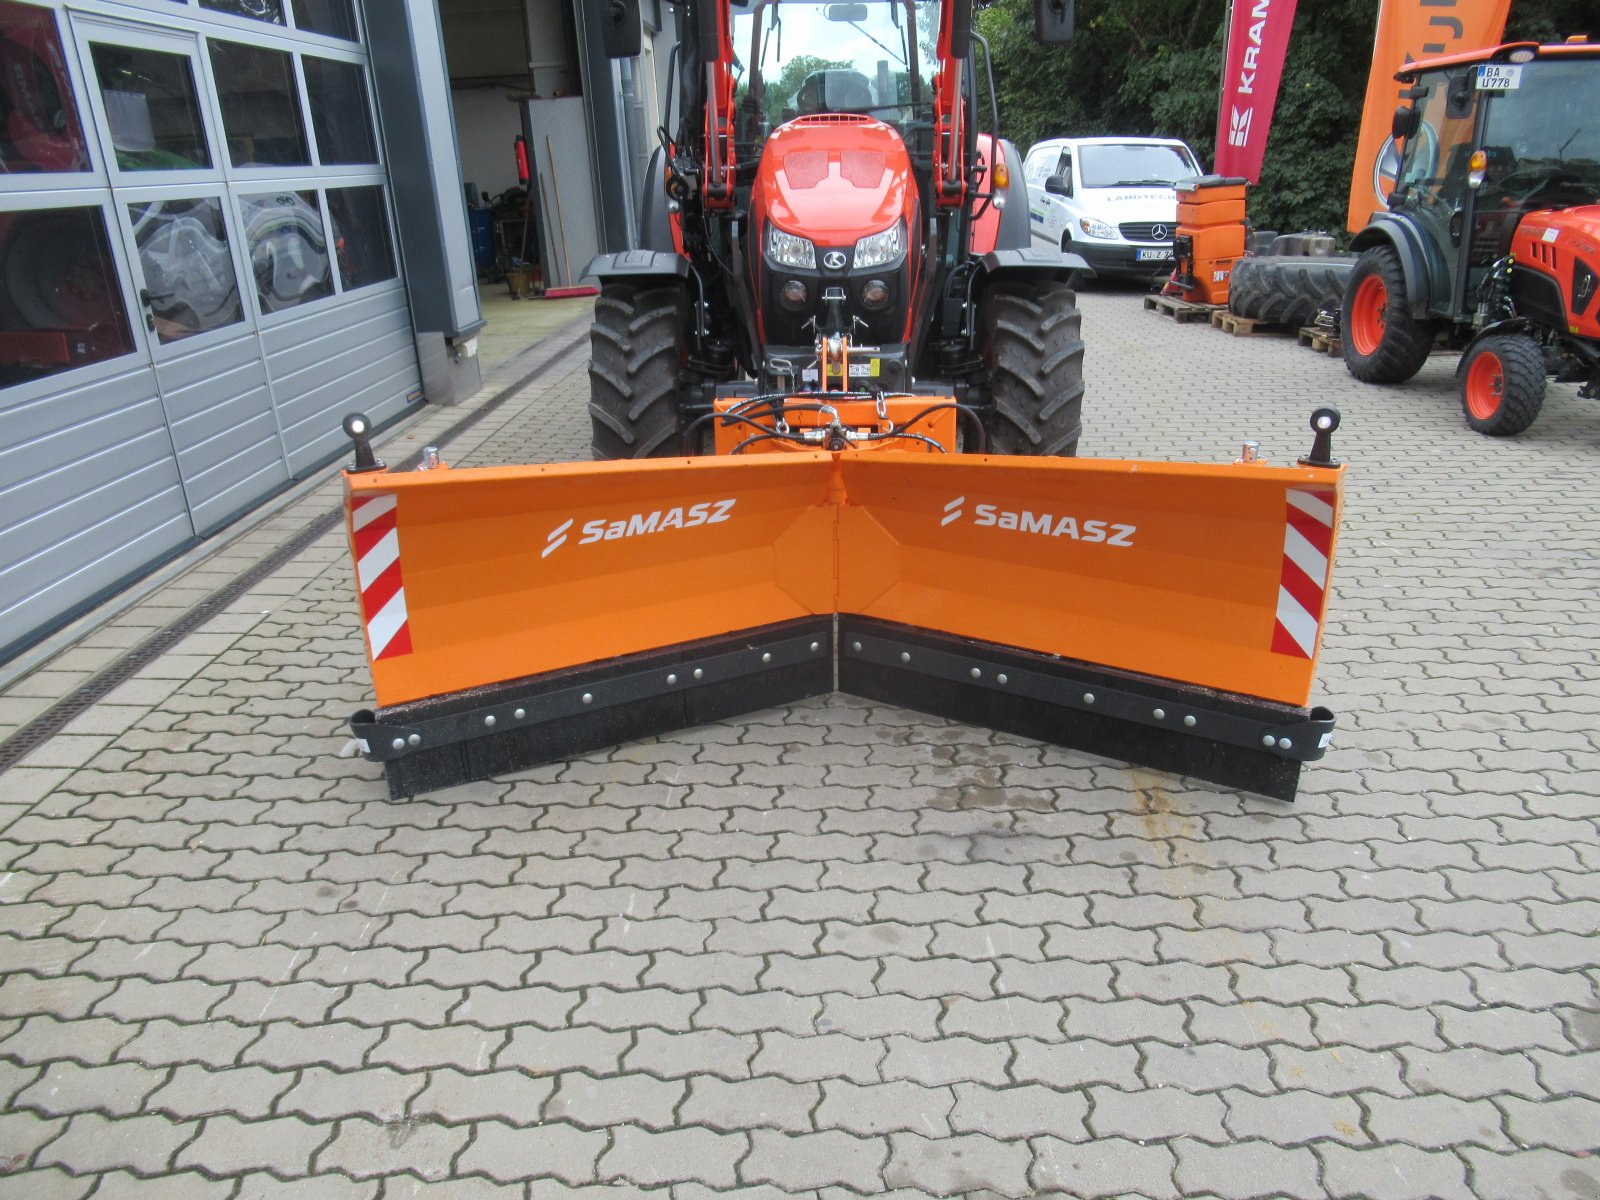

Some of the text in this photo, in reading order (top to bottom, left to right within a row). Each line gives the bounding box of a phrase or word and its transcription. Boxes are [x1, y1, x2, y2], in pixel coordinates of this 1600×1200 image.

[1486, 67, 1500, 77] BA
[578, 499, 737, 545] SaMASZ
[974, 504, 1137, 547] SaMASZ
